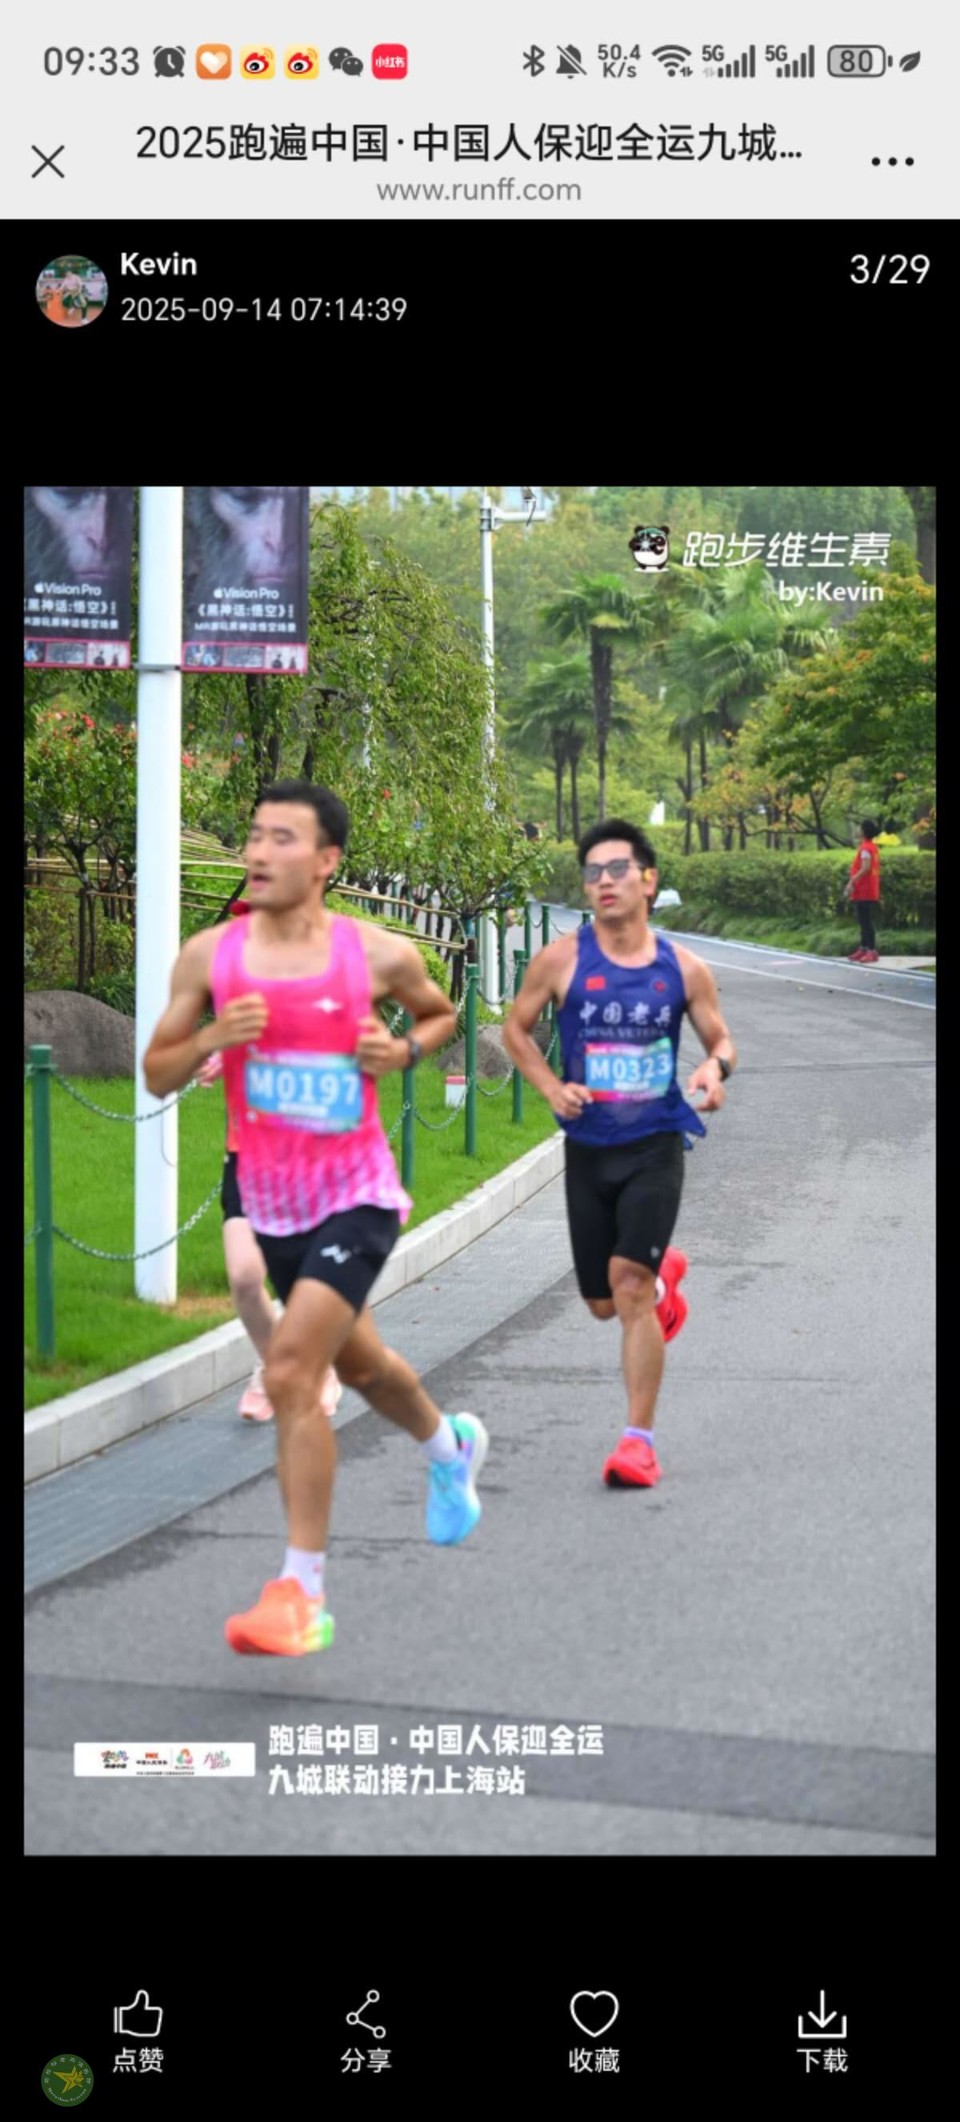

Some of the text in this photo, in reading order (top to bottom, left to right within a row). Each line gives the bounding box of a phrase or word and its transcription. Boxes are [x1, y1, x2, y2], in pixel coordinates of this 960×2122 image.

[44, 47, 140, 76] 09:33
[375, 56, 405, 68] 小红书
[597, 44, 641, 61] 50.4
[702, 45, 725, 62] 5G
[765, 45, 788, 62] 5G
[839, 50, 873, 73] 80
[603, 62, 637, 78] K/s
[377, 177, 581, 201] www.runff.com
[121, 252, 197, 276] Kevin
[850, 254, 930, 284] 3/29
[121, 298, 407, 321] 2025-09-14 07:14:39
[44, 583, 102, 596] Vision Pro
[224, 588, 279, 599] Vision Pro
[579, 1000, 671, 1027] 中国老兵
[590, 1053, 671, 1082] M0323
[248, 1067, 360, 1106] M0197
[112, 2047, 164, 2074] 点赞
[340, 2047, 392, 2074] 分享
[568, 2047, 620, 2074] 收藏
[796, 2047, 849, 2073] 下载
